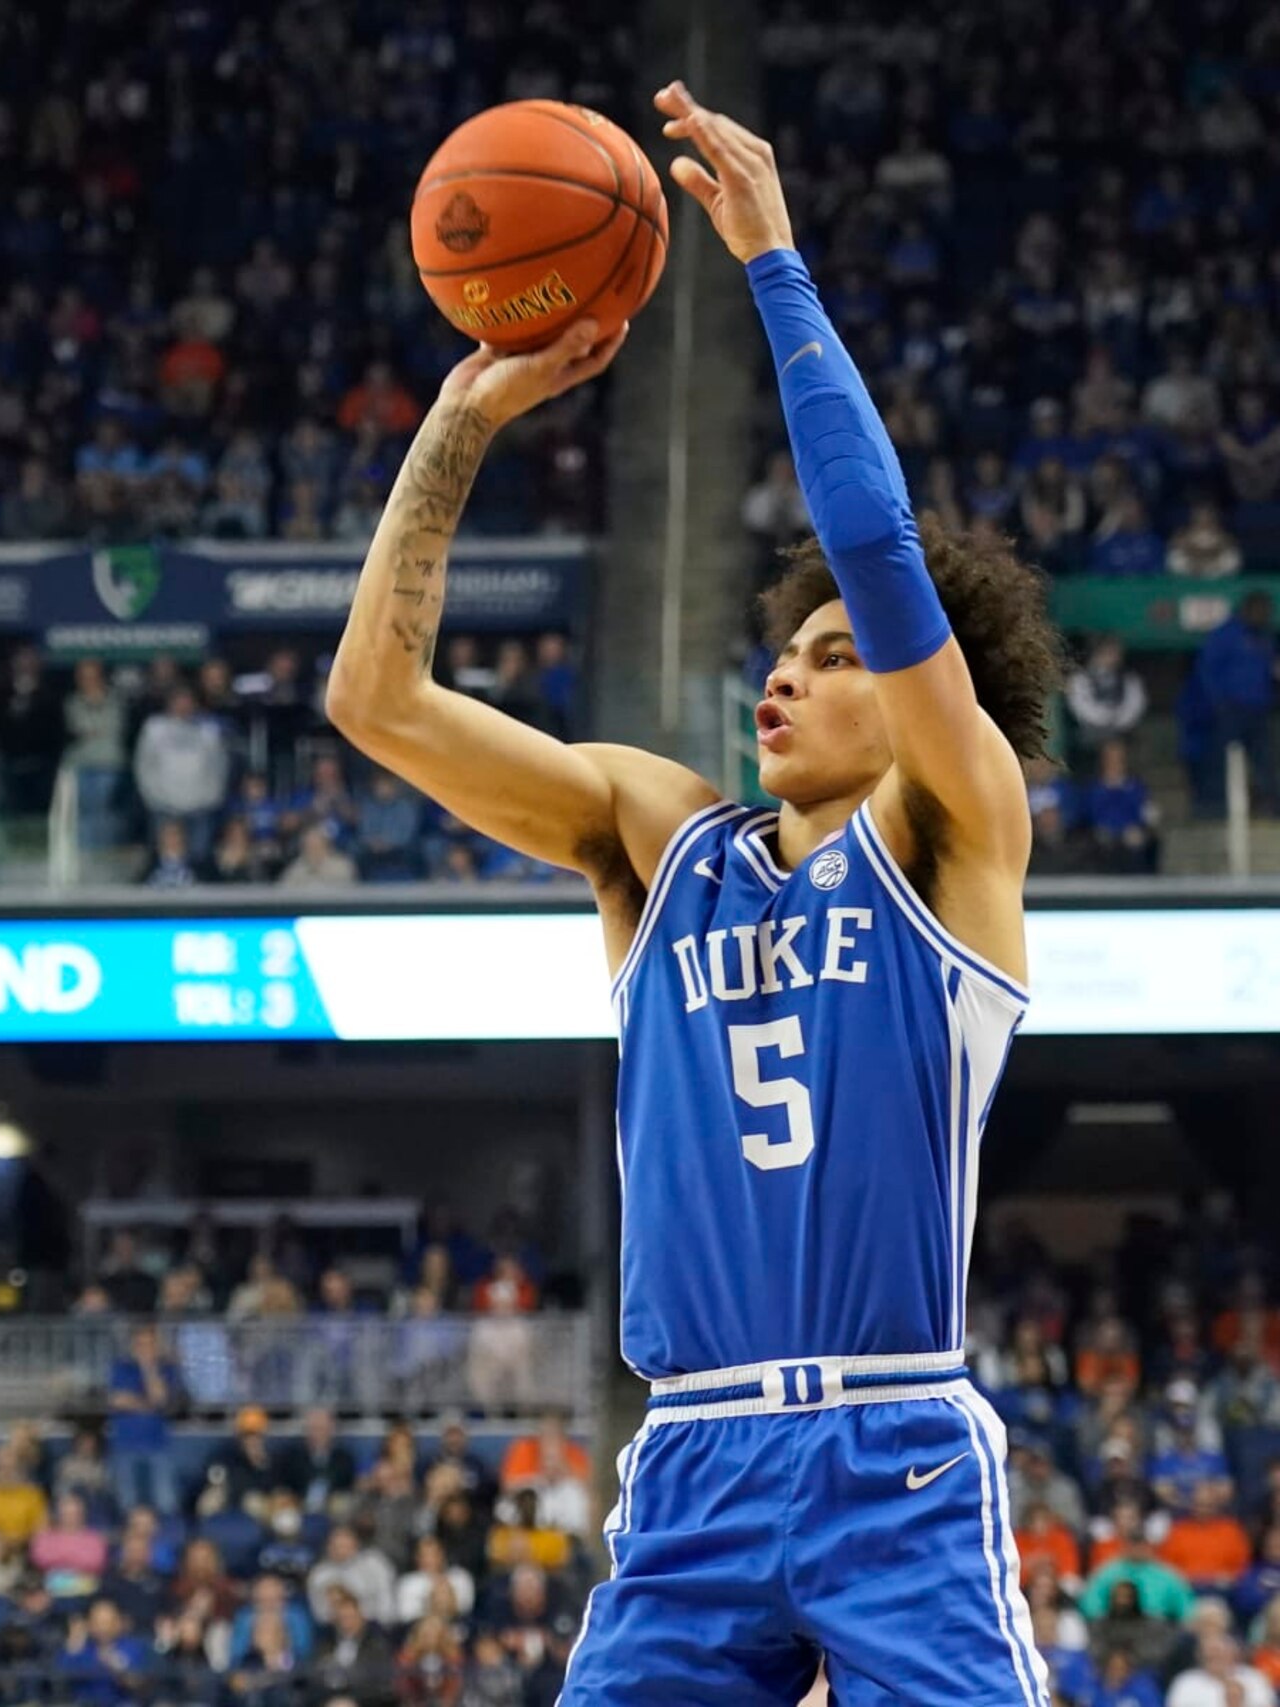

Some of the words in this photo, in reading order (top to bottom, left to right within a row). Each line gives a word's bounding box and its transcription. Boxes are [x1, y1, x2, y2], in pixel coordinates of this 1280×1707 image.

[261, 930, 297, 977] 2
[673, 907, 873, 1013] DUKE
[727, 1015, 815, 1171] 5
[778, 1363, 824, 1406] D
